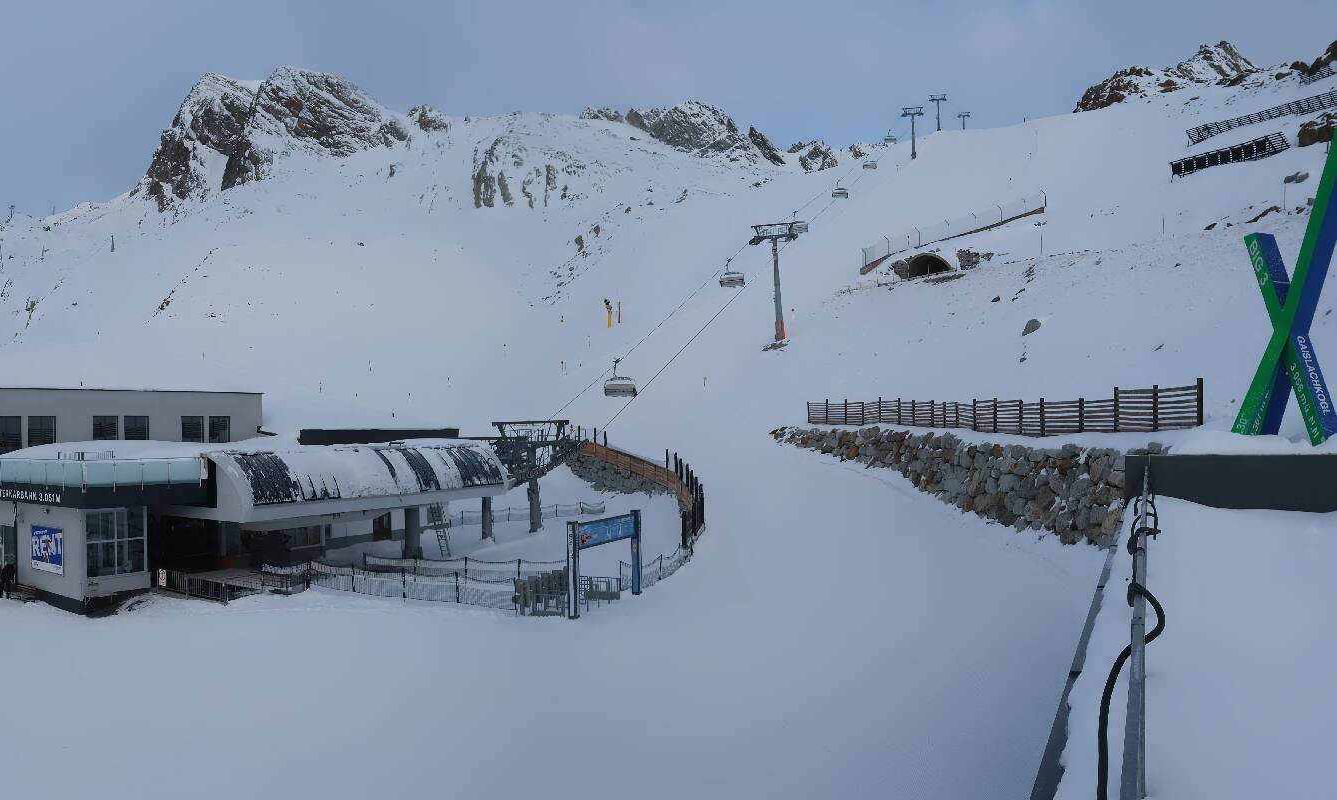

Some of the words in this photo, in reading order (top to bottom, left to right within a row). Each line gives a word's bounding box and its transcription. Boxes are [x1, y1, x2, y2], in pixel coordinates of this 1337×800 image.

[1249, 239, 1264, 272] BIG
[1260, 272, 1268, 286] 3
[1296, 335, 1331, 416] GAISLACHKOGL
[31, 533, 63, 557] RENT
